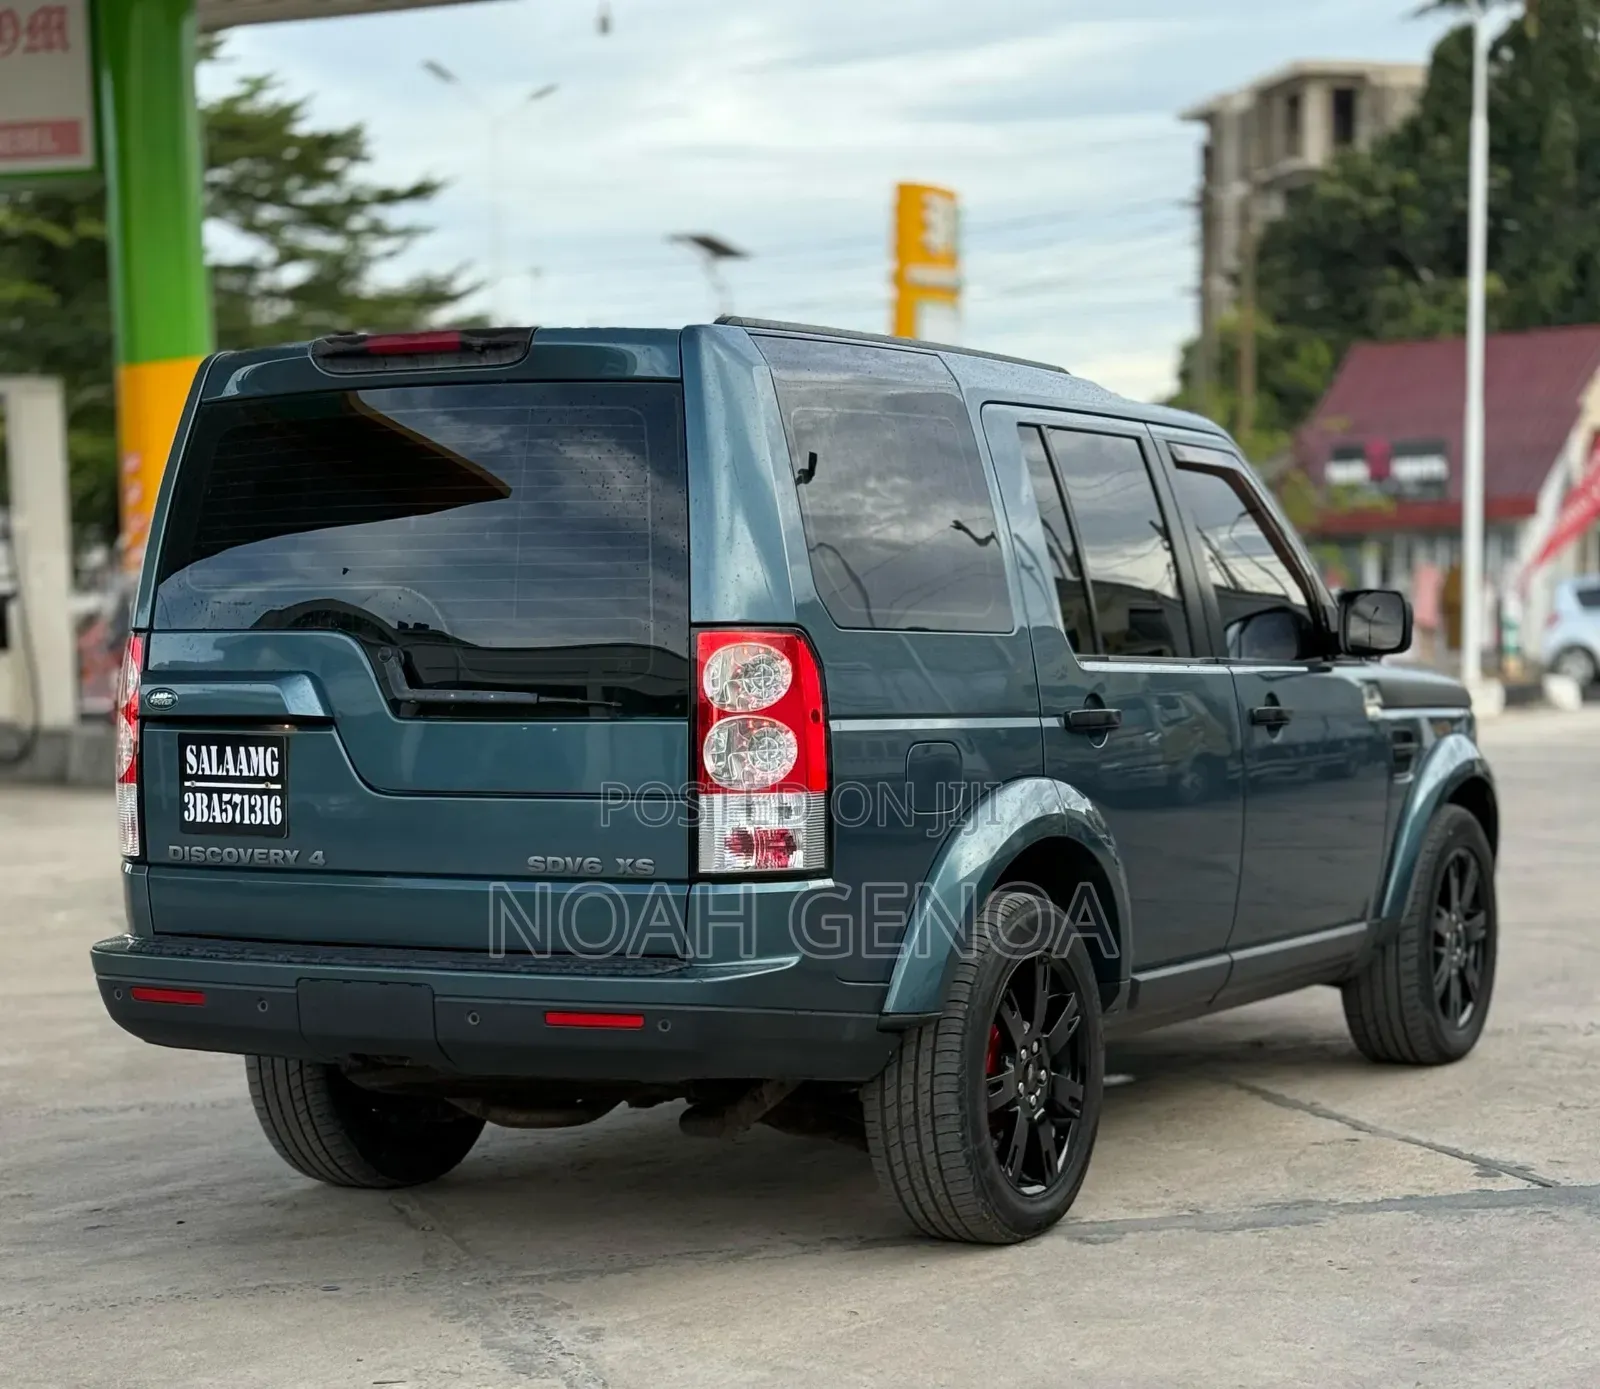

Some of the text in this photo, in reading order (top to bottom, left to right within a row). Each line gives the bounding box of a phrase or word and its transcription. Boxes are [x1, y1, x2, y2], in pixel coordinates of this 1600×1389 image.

[186, 745, 279, 777] SALAAMG
[183, 792, 282, 825] 3BA571316
[168, 846, 326, 866] DISCOVERY 4
[527, 855, 656, 875] SDV6 XS
